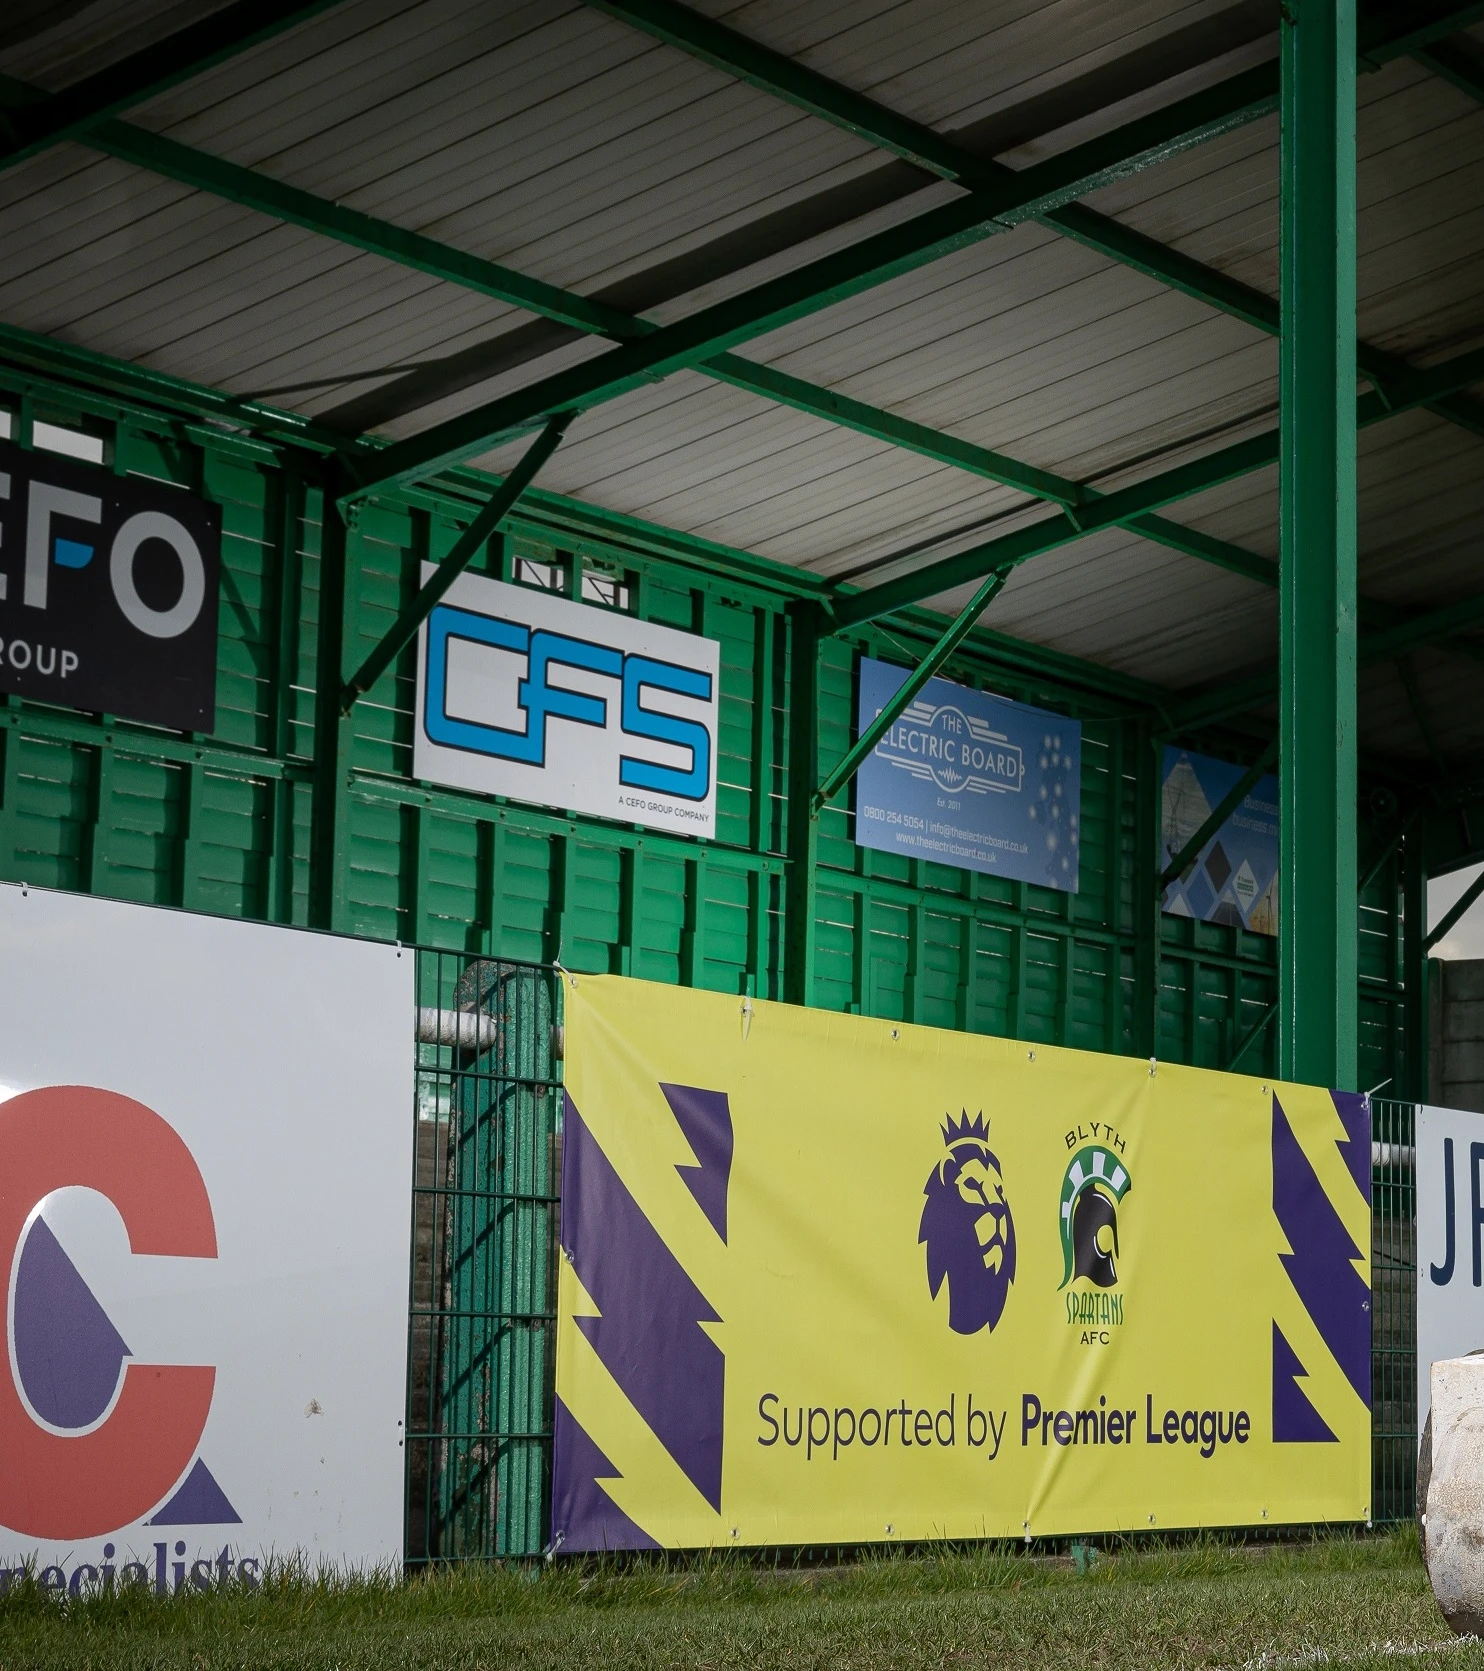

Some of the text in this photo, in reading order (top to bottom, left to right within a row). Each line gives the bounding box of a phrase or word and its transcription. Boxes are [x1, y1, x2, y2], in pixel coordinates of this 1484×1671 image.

[0, 471, 205, 638] FO
[0, 635, 78, 678] OUP
[424, 602, 713, 802] CFS
[941, 714, 962, 735] THE
[962, 744, 1017, 778] BOARD
[618, 796, 709, 822] A CEFO GROUP COMPANY
[863, 805, 886, 822] 0800
[886, 811, 902, 824] 254
[903, 815, 924, 830] 5054
[895, 832, 997, 864] www.theelectricboard.co.uk
[1064, 1122, 1127, 1154] BLYTH
[1066, 1292, 1124, 1326] SPARTANS
[1080, 1331, 1110, 1345] AFC
[757, 1392, 1251, 1461] Supported by Premier League
